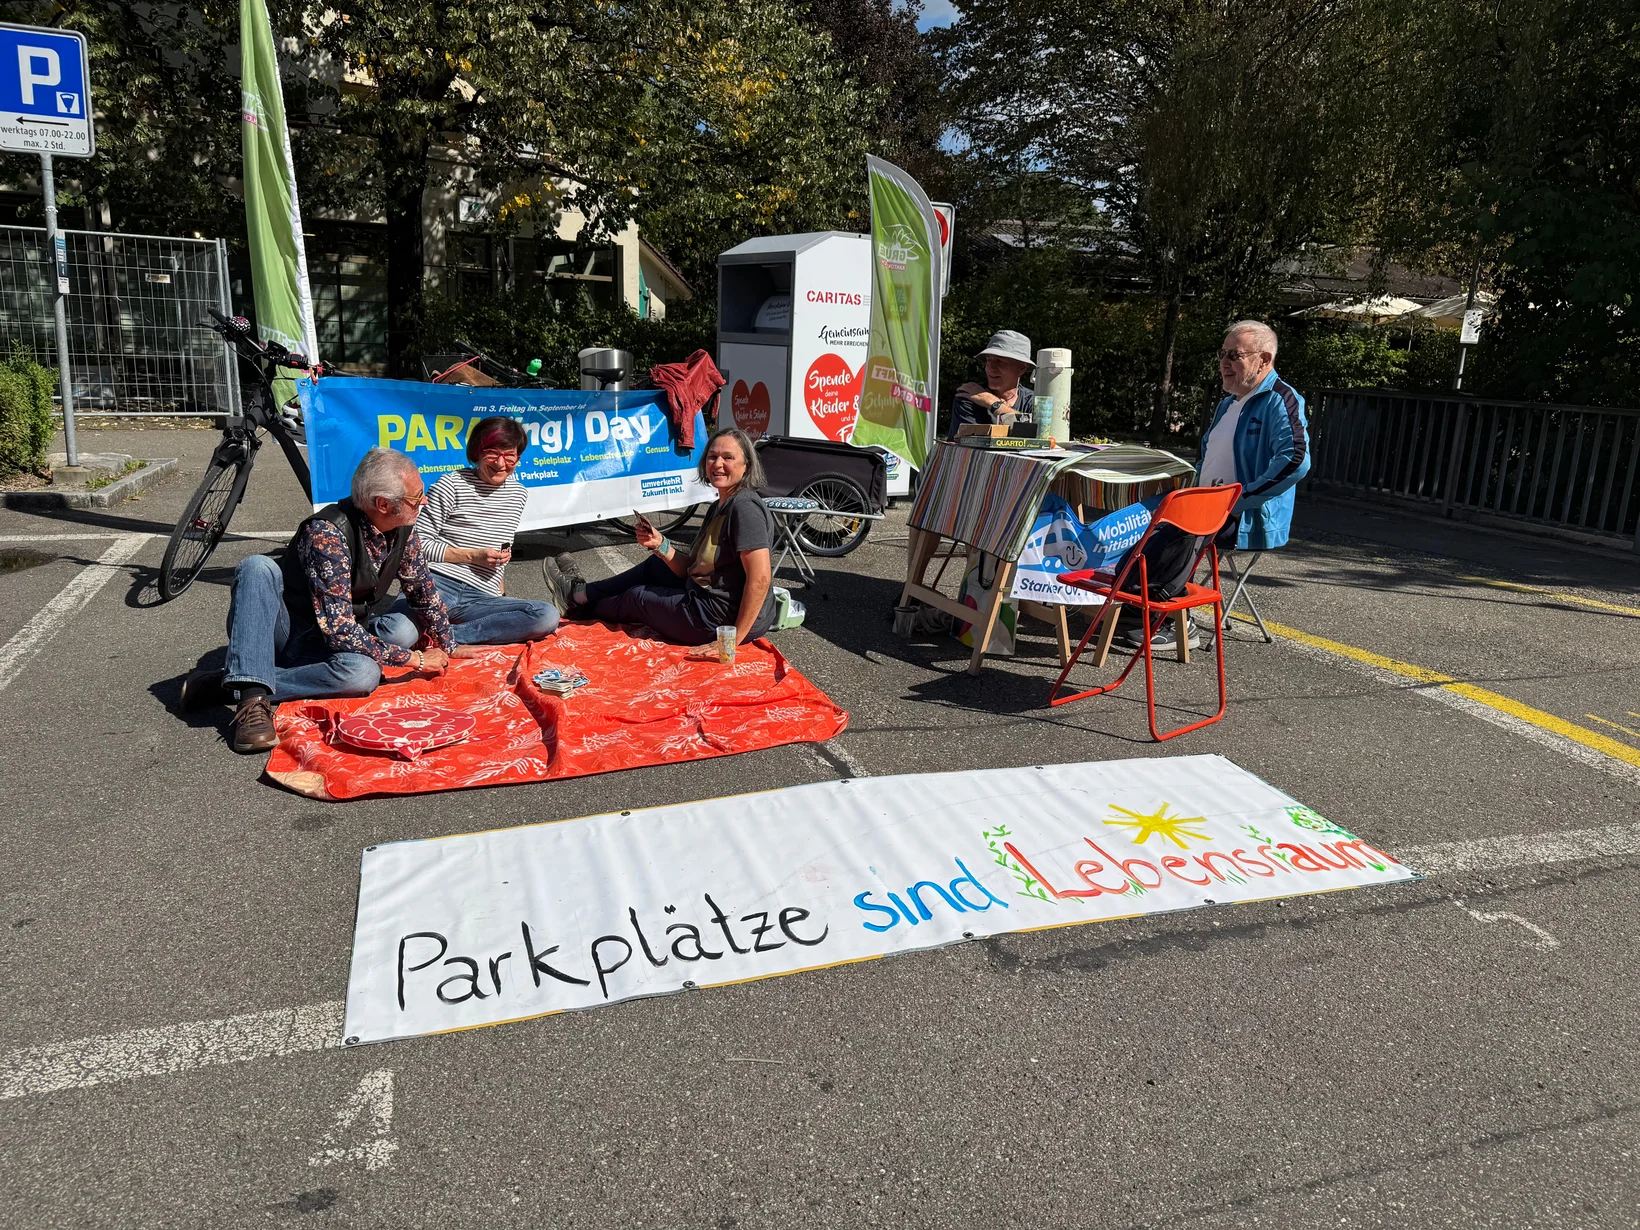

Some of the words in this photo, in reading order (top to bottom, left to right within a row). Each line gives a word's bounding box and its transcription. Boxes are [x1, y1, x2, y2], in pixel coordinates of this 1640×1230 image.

[17, 44, 62, 105] P
[0, 126, 38, 138] werktags
[39, 129, 86, 141] 07.00-22.00
[23, 140, 42, 149] max.
[44, 140, 49, 149] 2
[51, 141, 66, 150] Std.
[806, 289, 862, 306] CARITAS
[809, 369, 852, 392] Spende
[824, 389, 838, 397] deine
[473, 405, 487, 413] am
[489, 405, 497, 413] 3.
[499, 405, 526, 414] Freitag
[527, 404, 538, 412] im
[538, 404, 576, 413] September
[810, 397, 850, 418] Kleider
[584, 410, 651, 445] Day
[996, 439, 1026, 448] QUARTO!
[418, 463, 465, 474] ebensraum
[533, 456, 572, 466] Spielplatz
[580, 450, 635, 463] Lebensfreude
[645, 445, 670, 455] Genuss
[521, 470, 559, 480] Parkplatz
[642, 477, 682, 489] umverkehR
[642, 488, 669, 498] Zukunft
[669, 486, 685, 496] inkl.
[1019, 577, 1063, 595] Starker
[396, 892, 830, 1012] Parkplätze
[853, 856, 1010, 932] sind
[1003, 835, 1402, 900] Lebensraum
